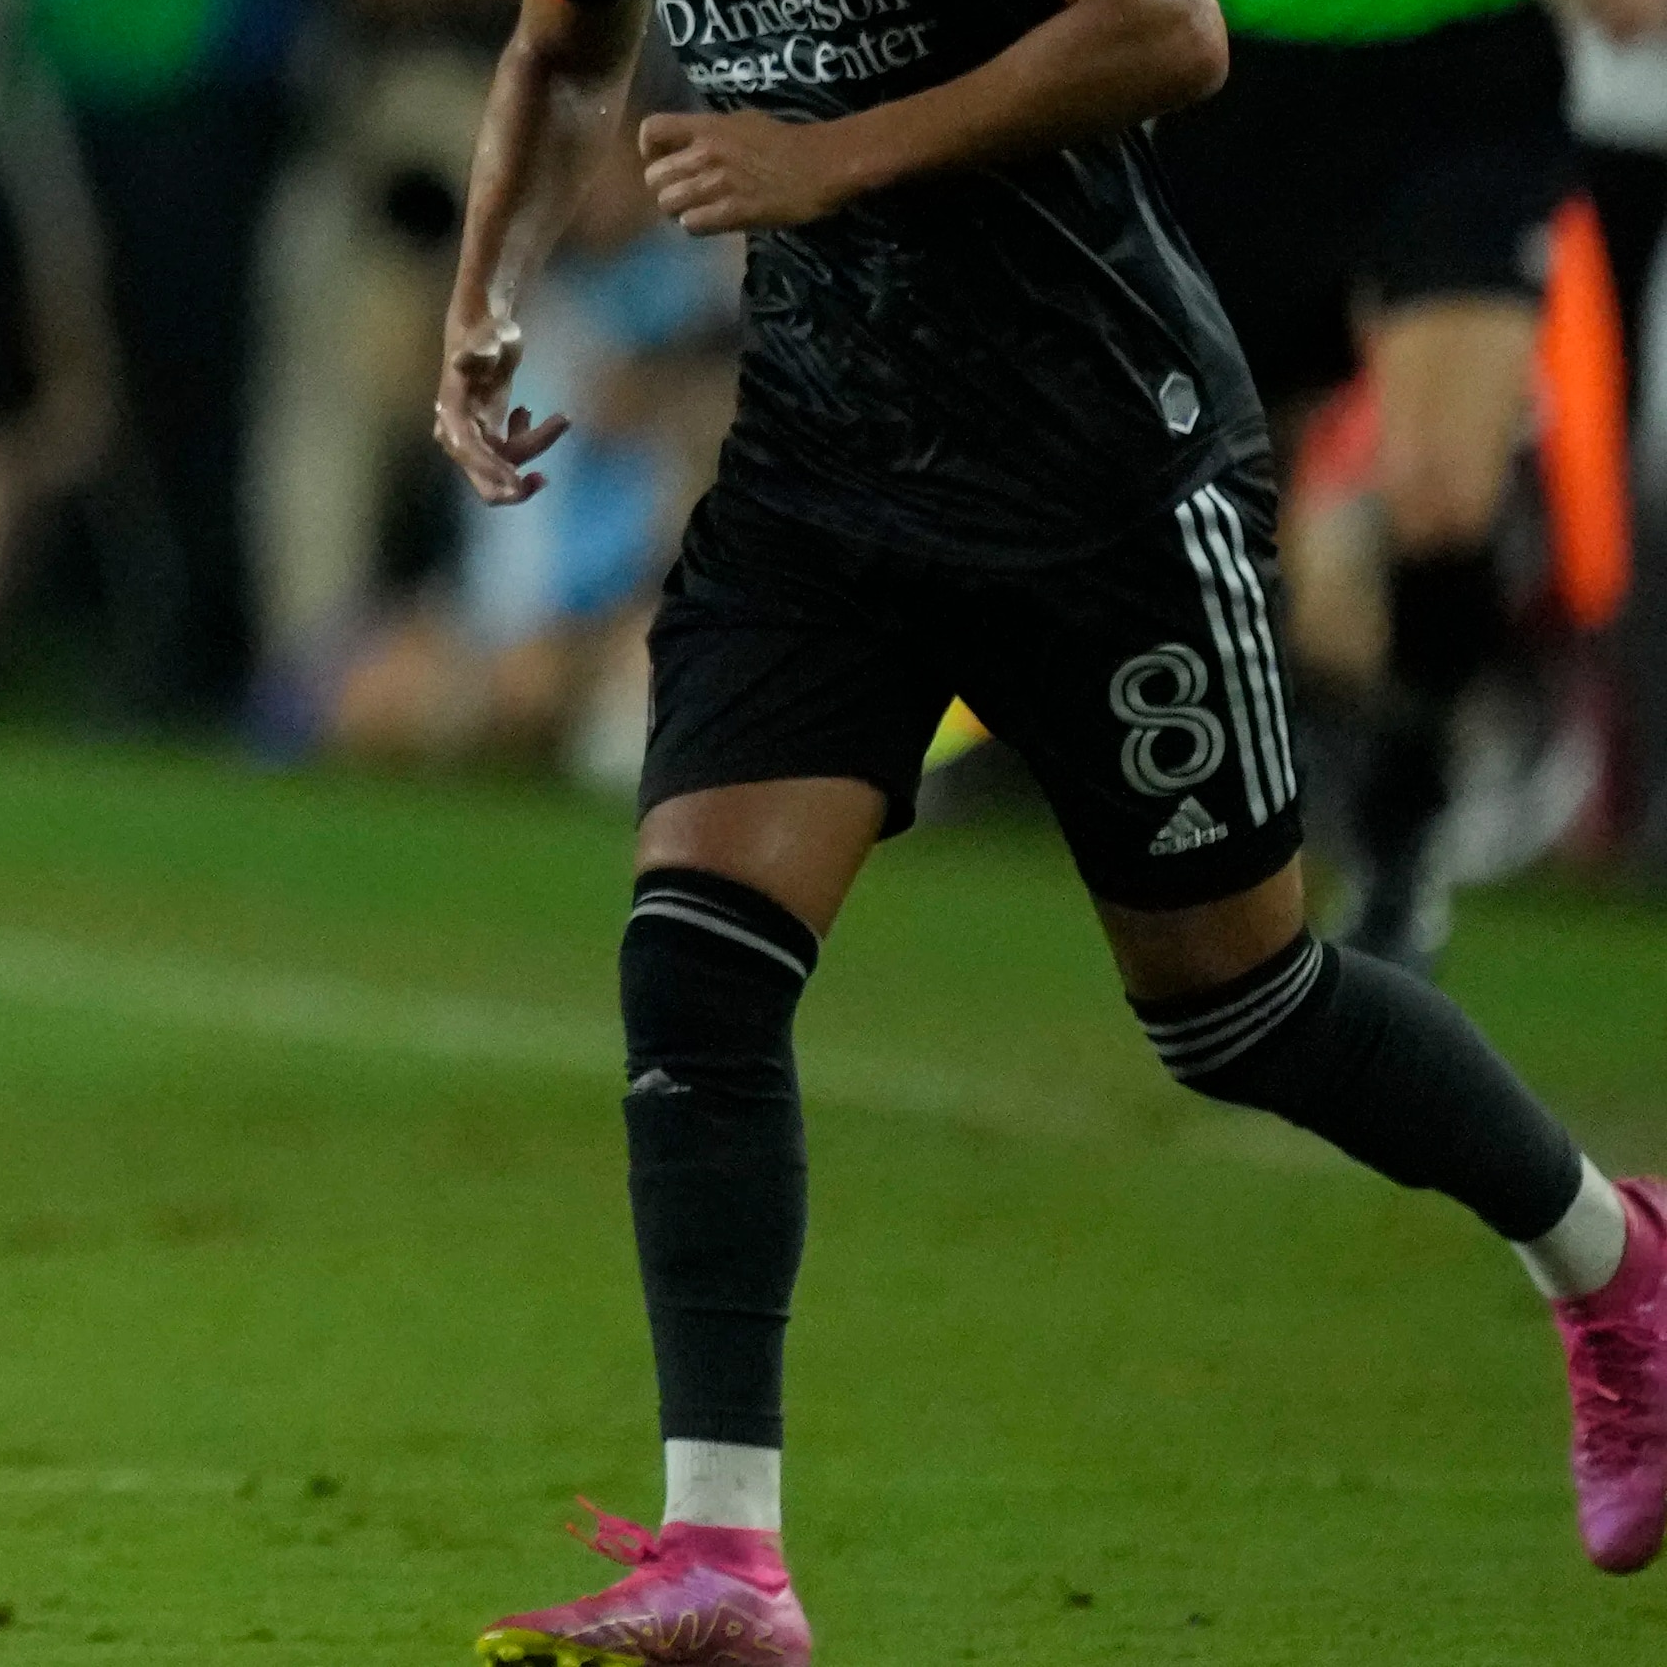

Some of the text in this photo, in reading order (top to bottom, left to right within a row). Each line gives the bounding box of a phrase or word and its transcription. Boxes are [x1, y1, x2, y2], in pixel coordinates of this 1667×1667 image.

[783, 23, 930, 85] Center
[1108, 641, 1226, 798] 8
[1148, 821, 1229, 857] adidas
